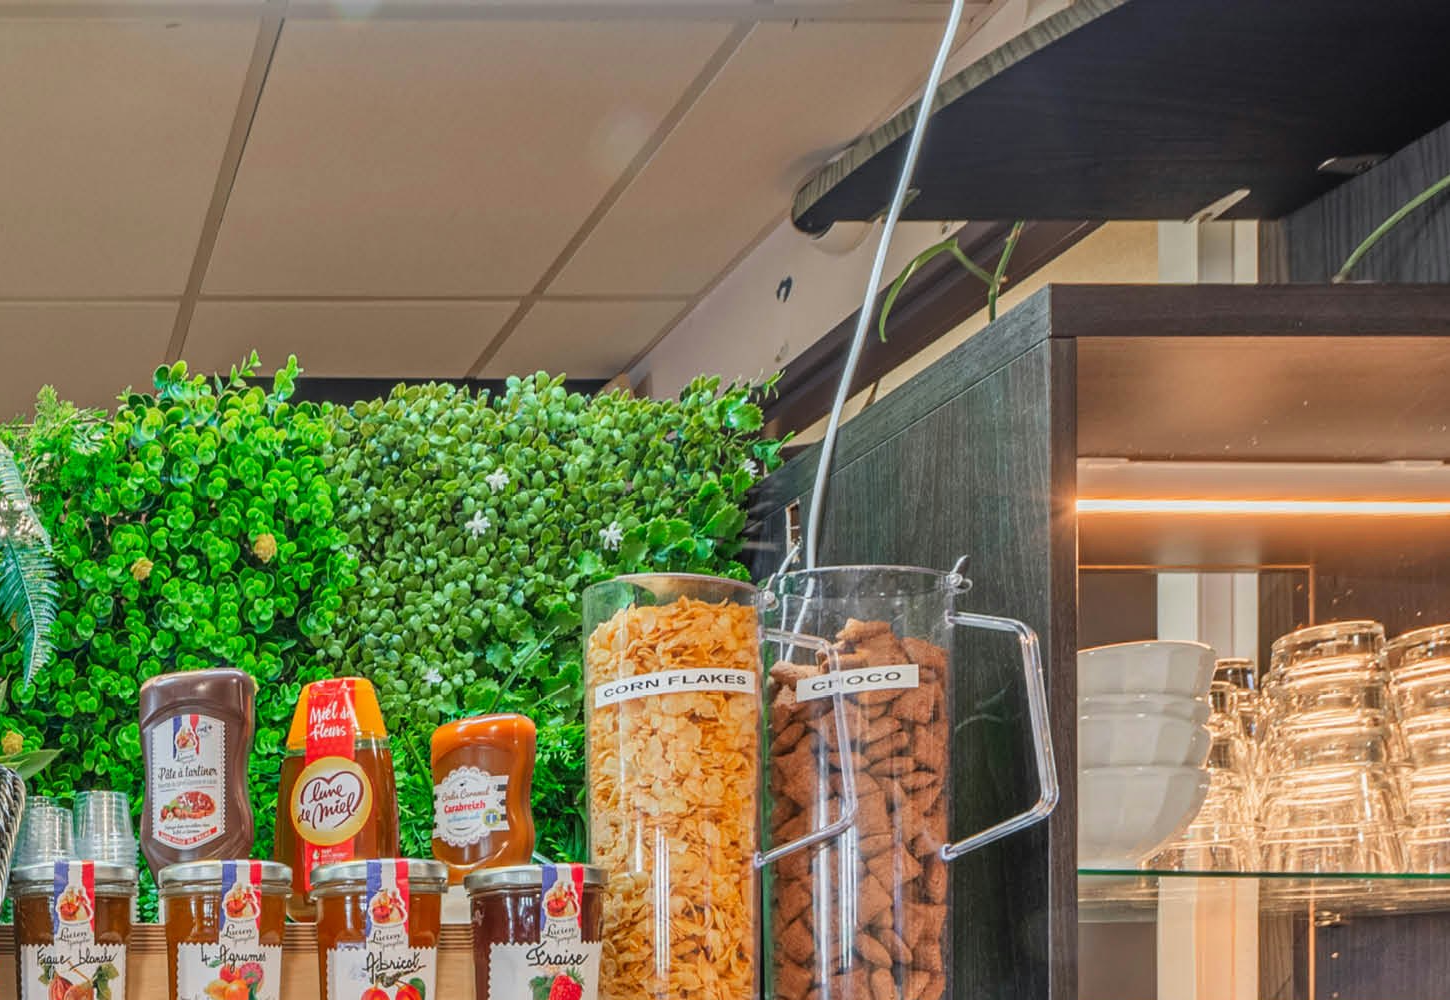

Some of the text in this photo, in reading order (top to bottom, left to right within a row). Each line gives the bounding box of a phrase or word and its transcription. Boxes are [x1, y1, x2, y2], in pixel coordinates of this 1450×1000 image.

[604, 674, 747, 698] CORN FLAKES
[310, 701, 337, 724] Miel
[298, 807, 311, 824] de
[221, 924, 253, 938] Lucien
[369, 929, 401, 944] Lucien
[542, 924, 576, 938] Lucien
[70, 950, 118, 970] blanche
[200, 945, 266, 973] 4 Agrumes
[362, 952, 421, 976] Abricot
[526, 941, 589, 967] Fraise
